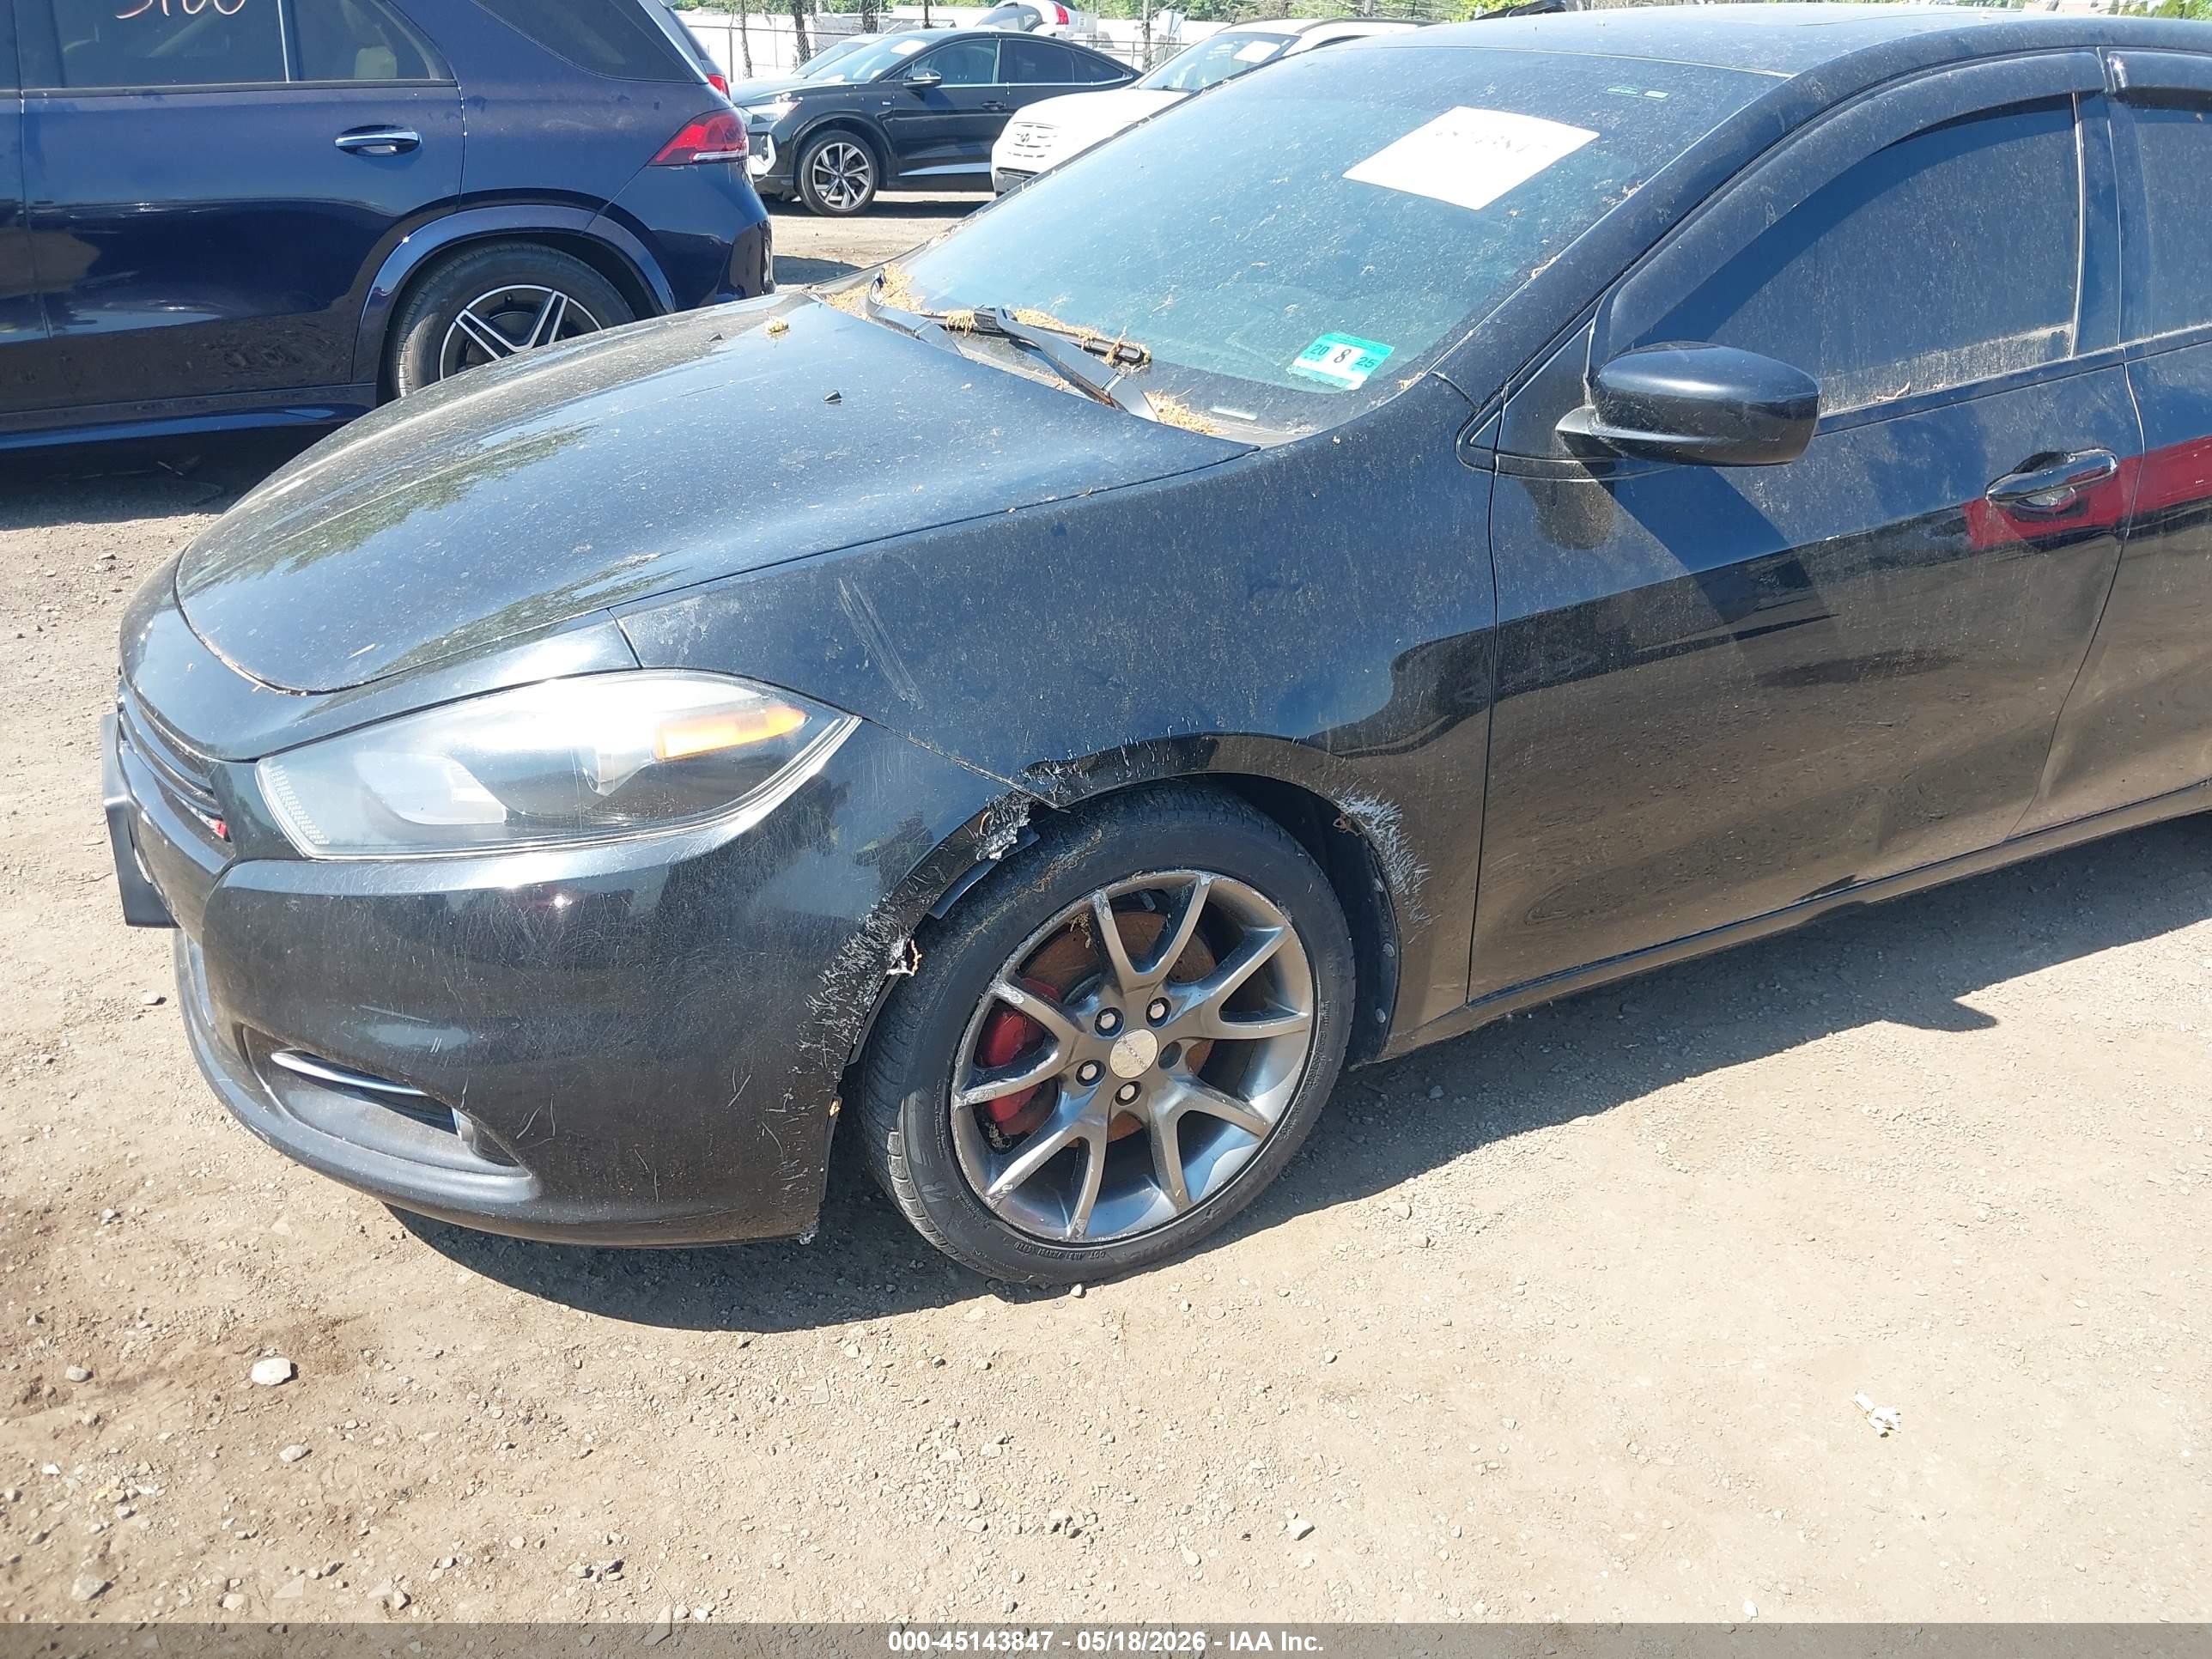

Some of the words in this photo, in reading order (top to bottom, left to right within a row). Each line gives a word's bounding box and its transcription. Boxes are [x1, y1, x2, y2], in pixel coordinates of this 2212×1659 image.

[1310, 344, 1330, 356] 20
[1334, 349, 1352, 363] 8
[1355, 356, 1376, 368] 25
